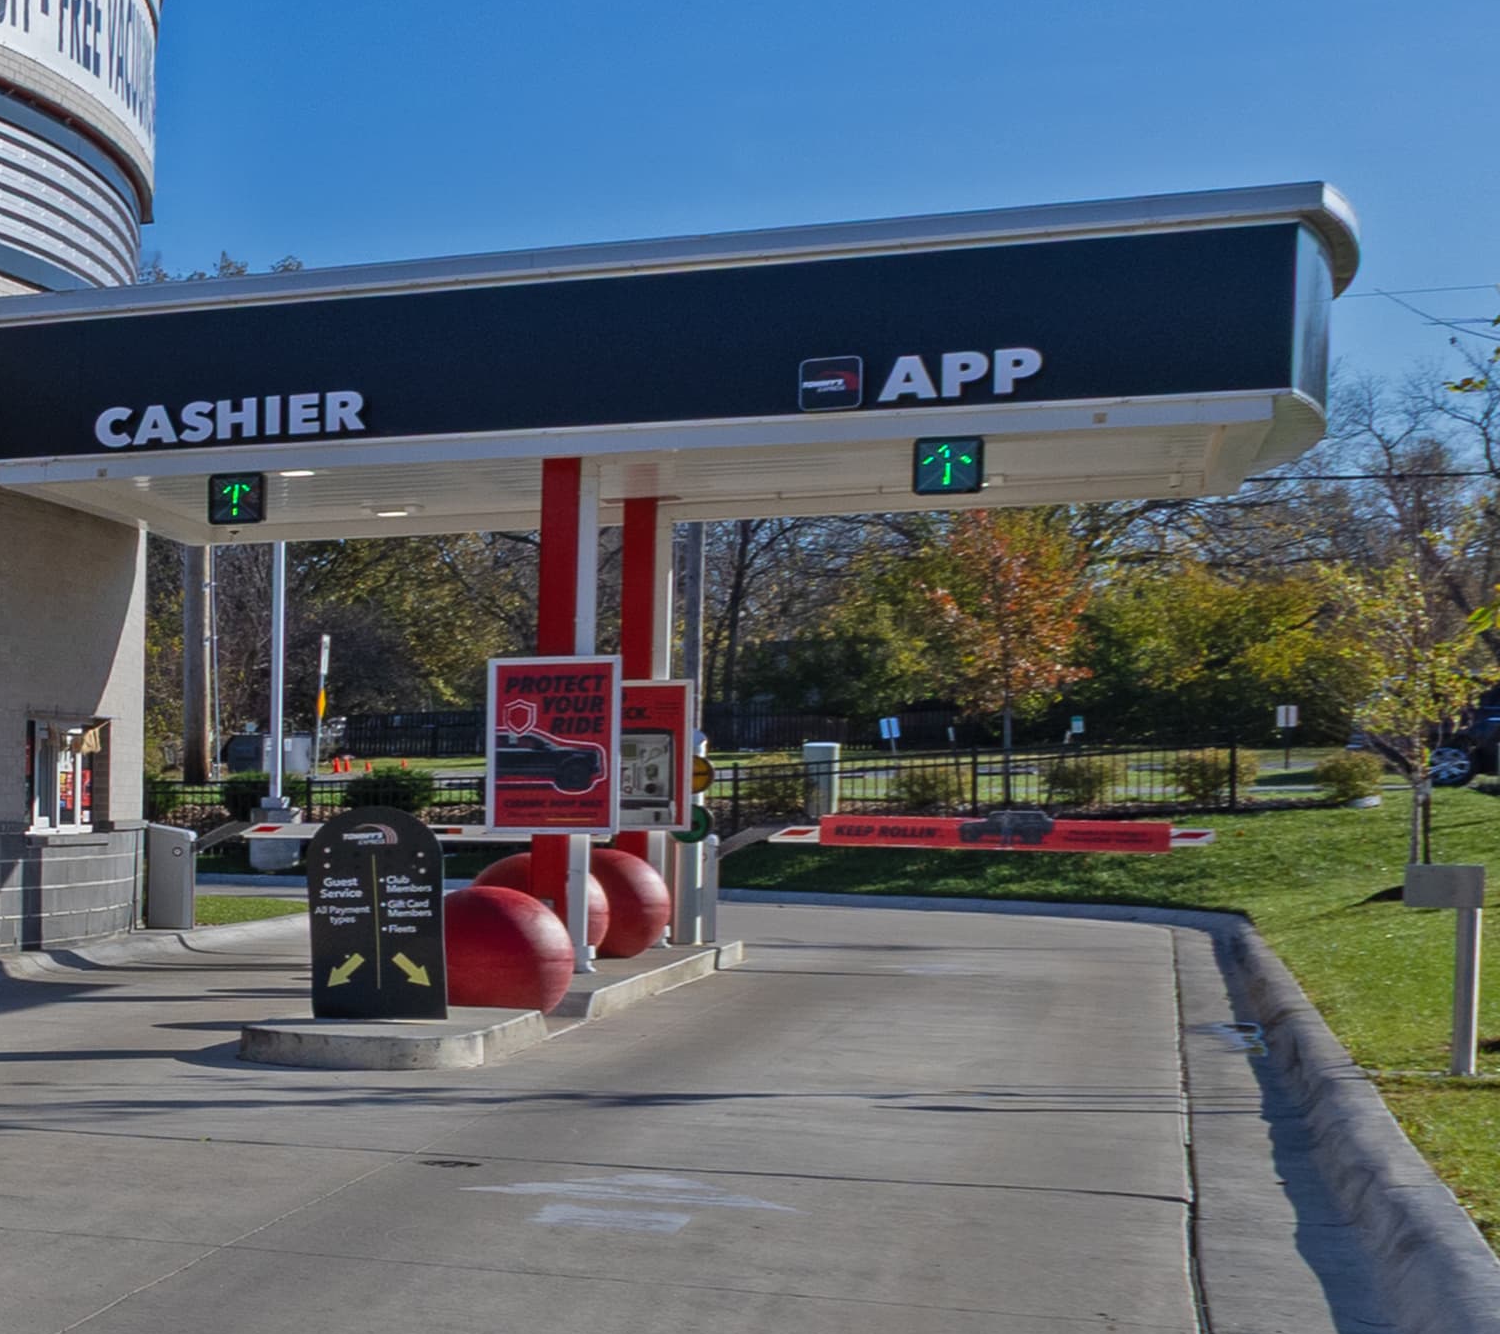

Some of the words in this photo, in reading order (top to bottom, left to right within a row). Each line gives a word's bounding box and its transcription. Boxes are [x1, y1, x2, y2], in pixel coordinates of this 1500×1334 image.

[877, 347, 1043, 402] APP
[95, 390, 365, 448] CASHIER
[505, 674, 606, 693] PROTECT
[542, 696, 605, 714] YOUR
[551, 716, 605, 734] RIDE
[835, 824, 875, 837] KEEP
[323, 877, 358, 887] Guest
[386, 875, 410, 884] Club
[319, 888, 363, 899] Service
[386, 884, 432, 893] Members
[406, 899, 430, 908] Card
[329, 906, 371, 916] Payment
[387, 909, 433, 917] Members
[329, 916, 356, 926] types
